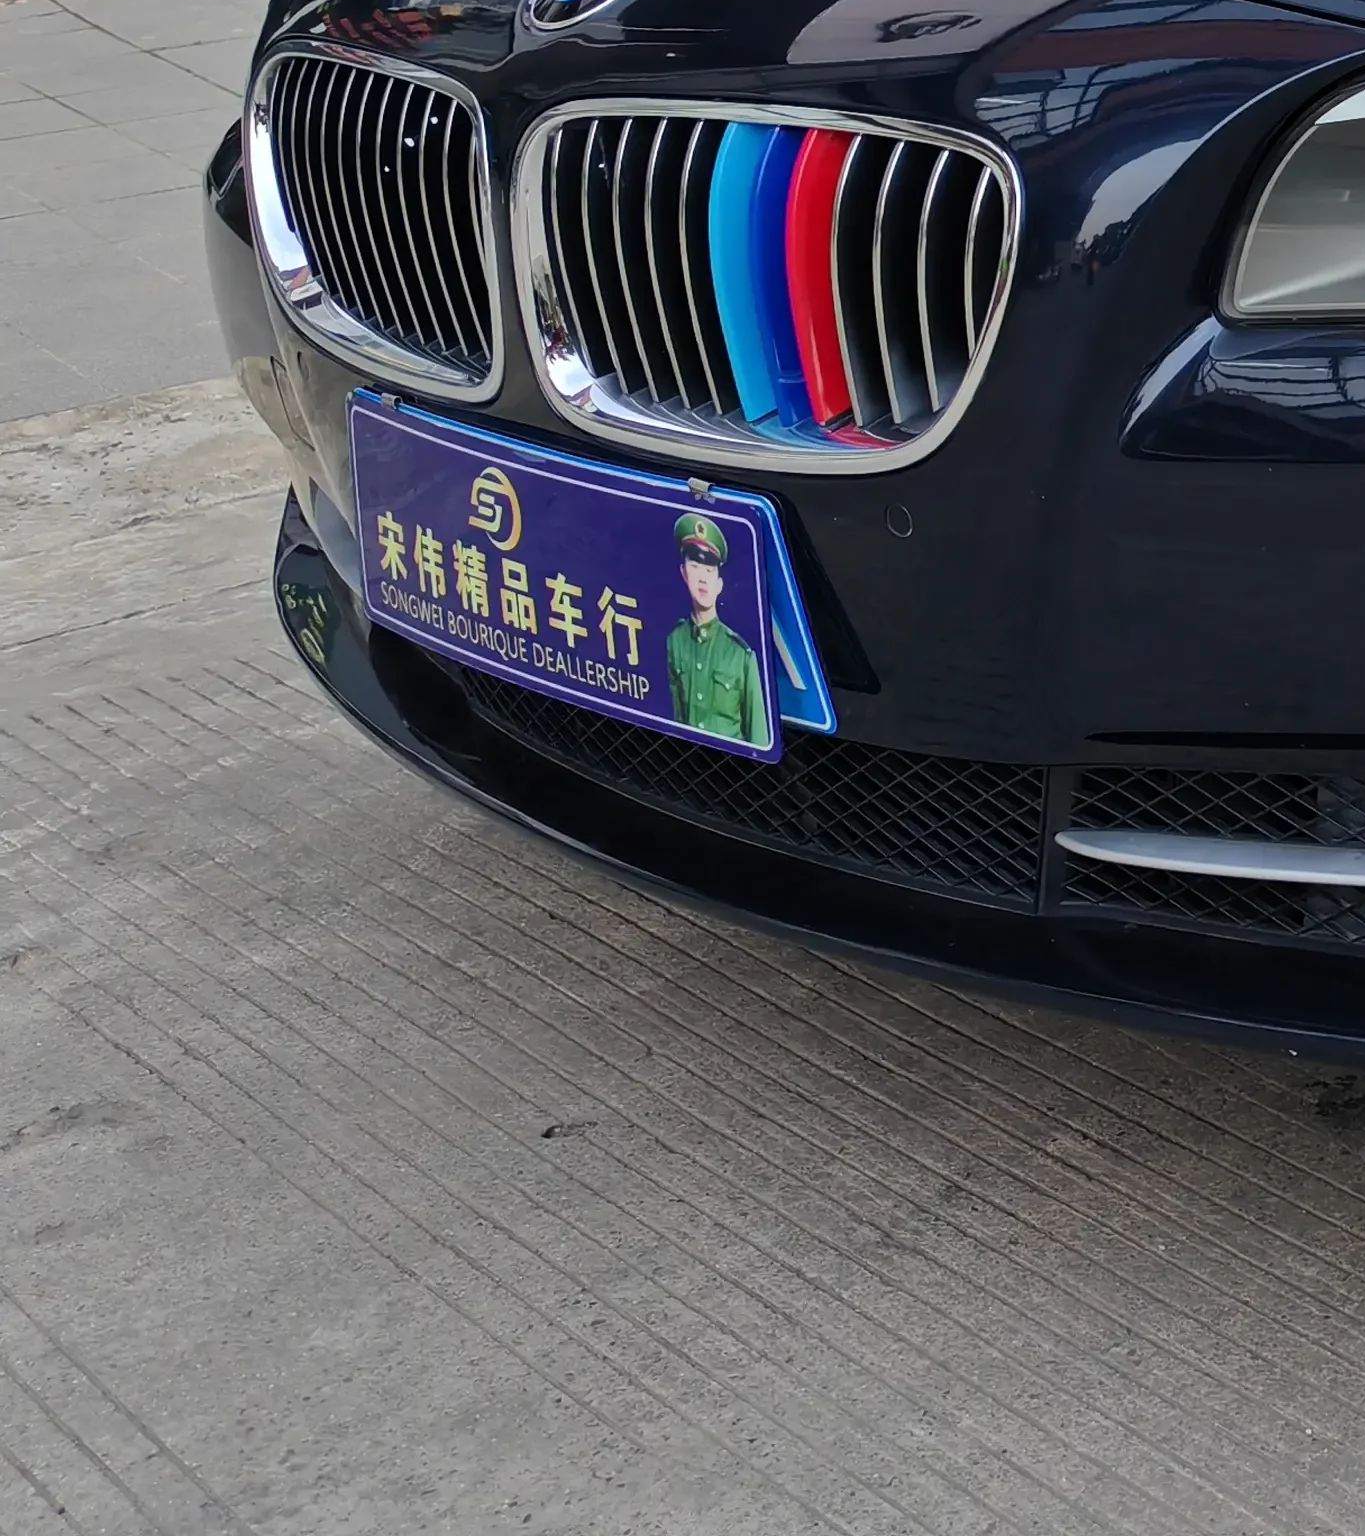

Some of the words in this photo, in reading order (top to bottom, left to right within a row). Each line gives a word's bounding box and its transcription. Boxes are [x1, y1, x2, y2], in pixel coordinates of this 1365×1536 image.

[377, 511, 644, 666] 宋伟精品车行
[381, 580, 444, 630] SONGWEI
[447, 610, 528, 662] BOURIQUE
[532, 642, 650, 700] DEALLERSHIP
